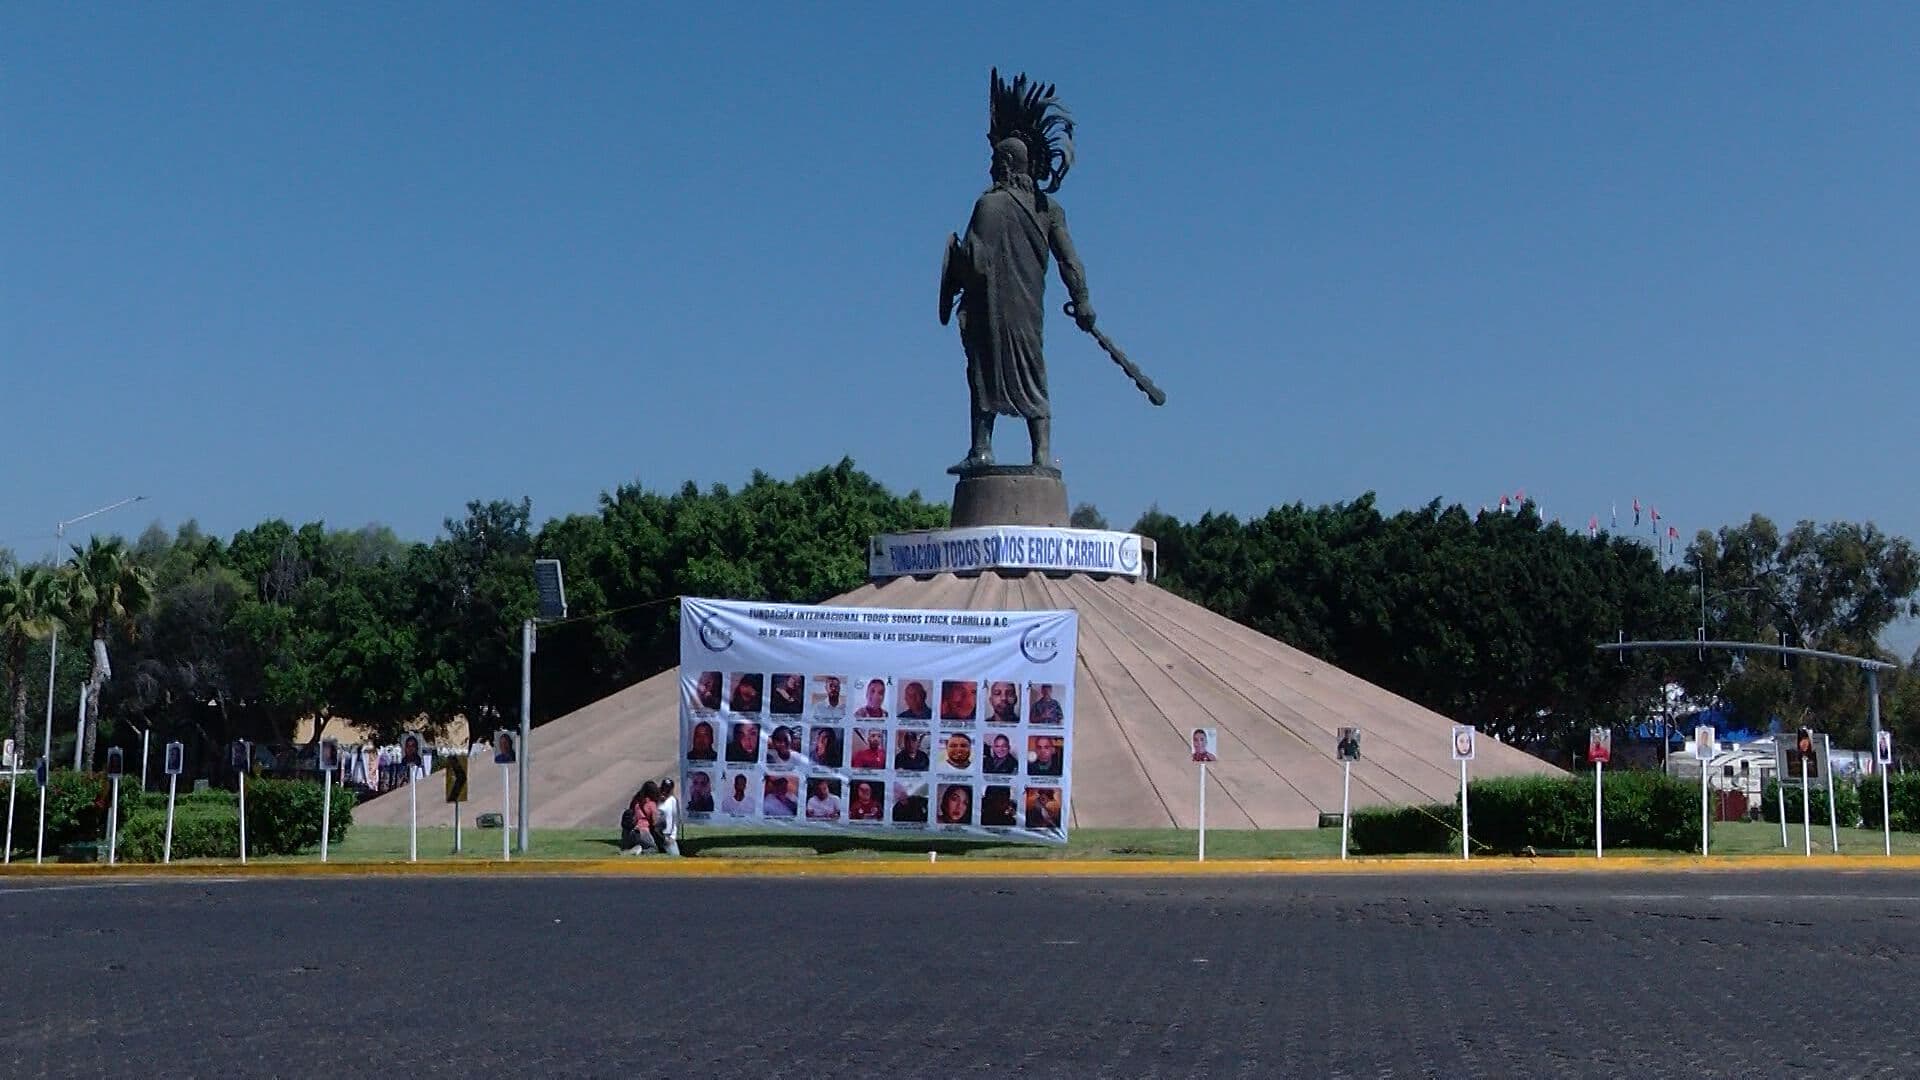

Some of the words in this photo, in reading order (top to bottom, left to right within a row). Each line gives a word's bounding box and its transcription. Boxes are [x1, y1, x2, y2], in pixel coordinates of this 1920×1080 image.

[943, 539, 981, 568] TODOS
[983, 534, 1024, 564] SOMOS
[1028, 537, 1062, 565] ERICK
[1066, 539, 1114, 568] CARRILLO
[796, 611, 859, 623] INTERNACIONAL
[862, 613, 889, 624] TODOS
[892, 614, 922, 624] SOMOS
[924, 615, 949, 625] ERICK
[951, 616, 991, 627] CARRILLO
[820, 631, 870, 640] INTERNACIONAL
[883, 632, 896, 642] LAS
